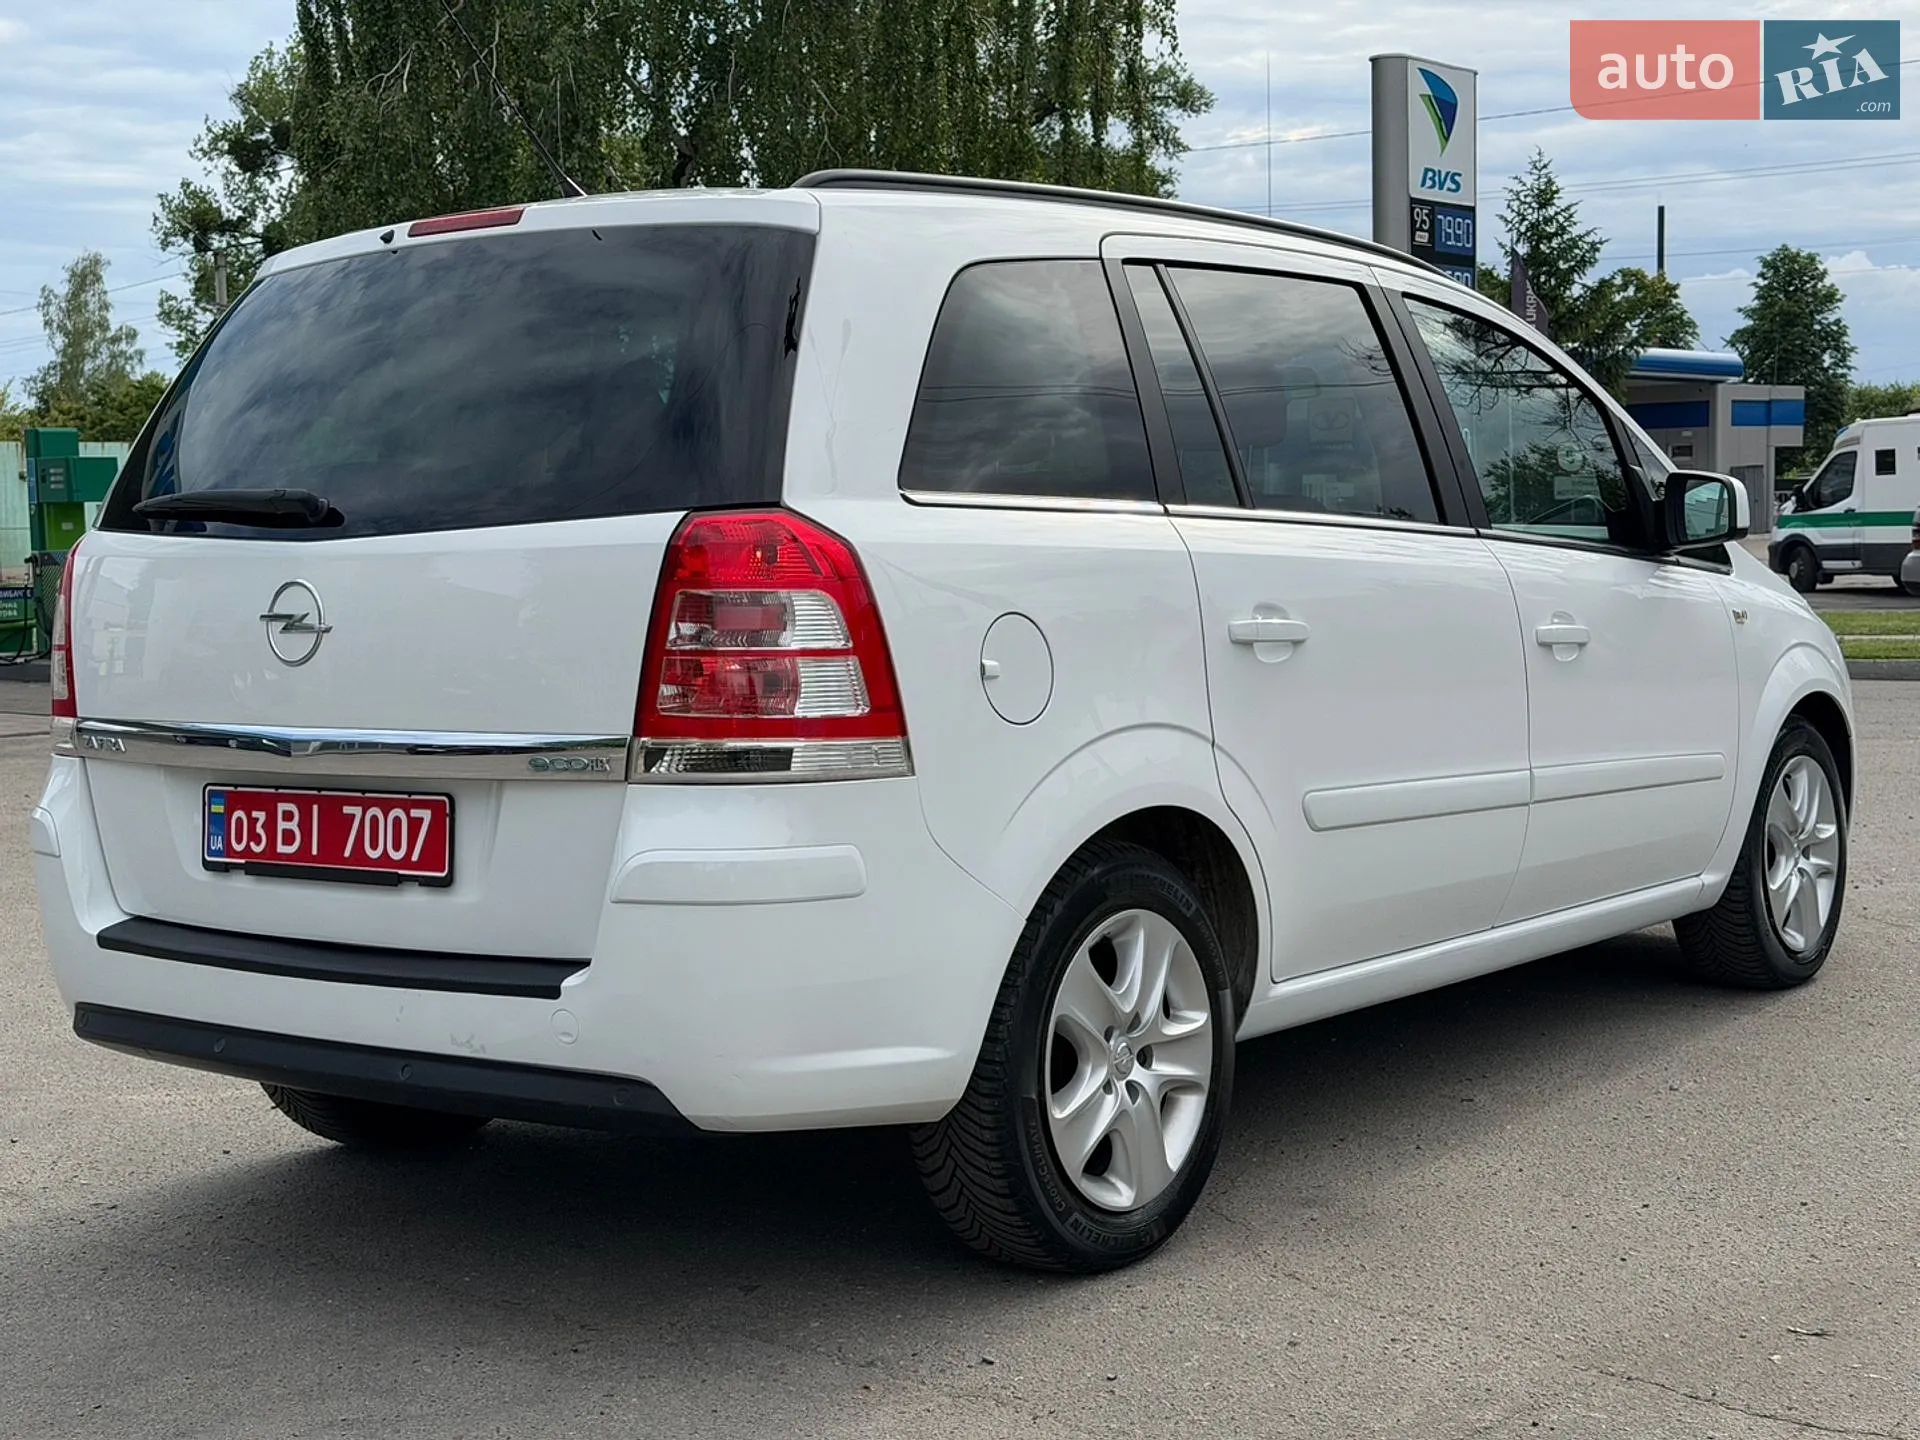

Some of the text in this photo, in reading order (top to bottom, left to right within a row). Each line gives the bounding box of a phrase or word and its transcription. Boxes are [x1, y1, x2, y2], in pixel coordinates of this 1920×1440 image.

[1420, 167, 1462, 193] BVS
[1414, 208, 1430, 230] 95
[210, 836, 224, 851] UA
[230, 810, 267, 853] 03
[342, 806, 432, 862] 7007
